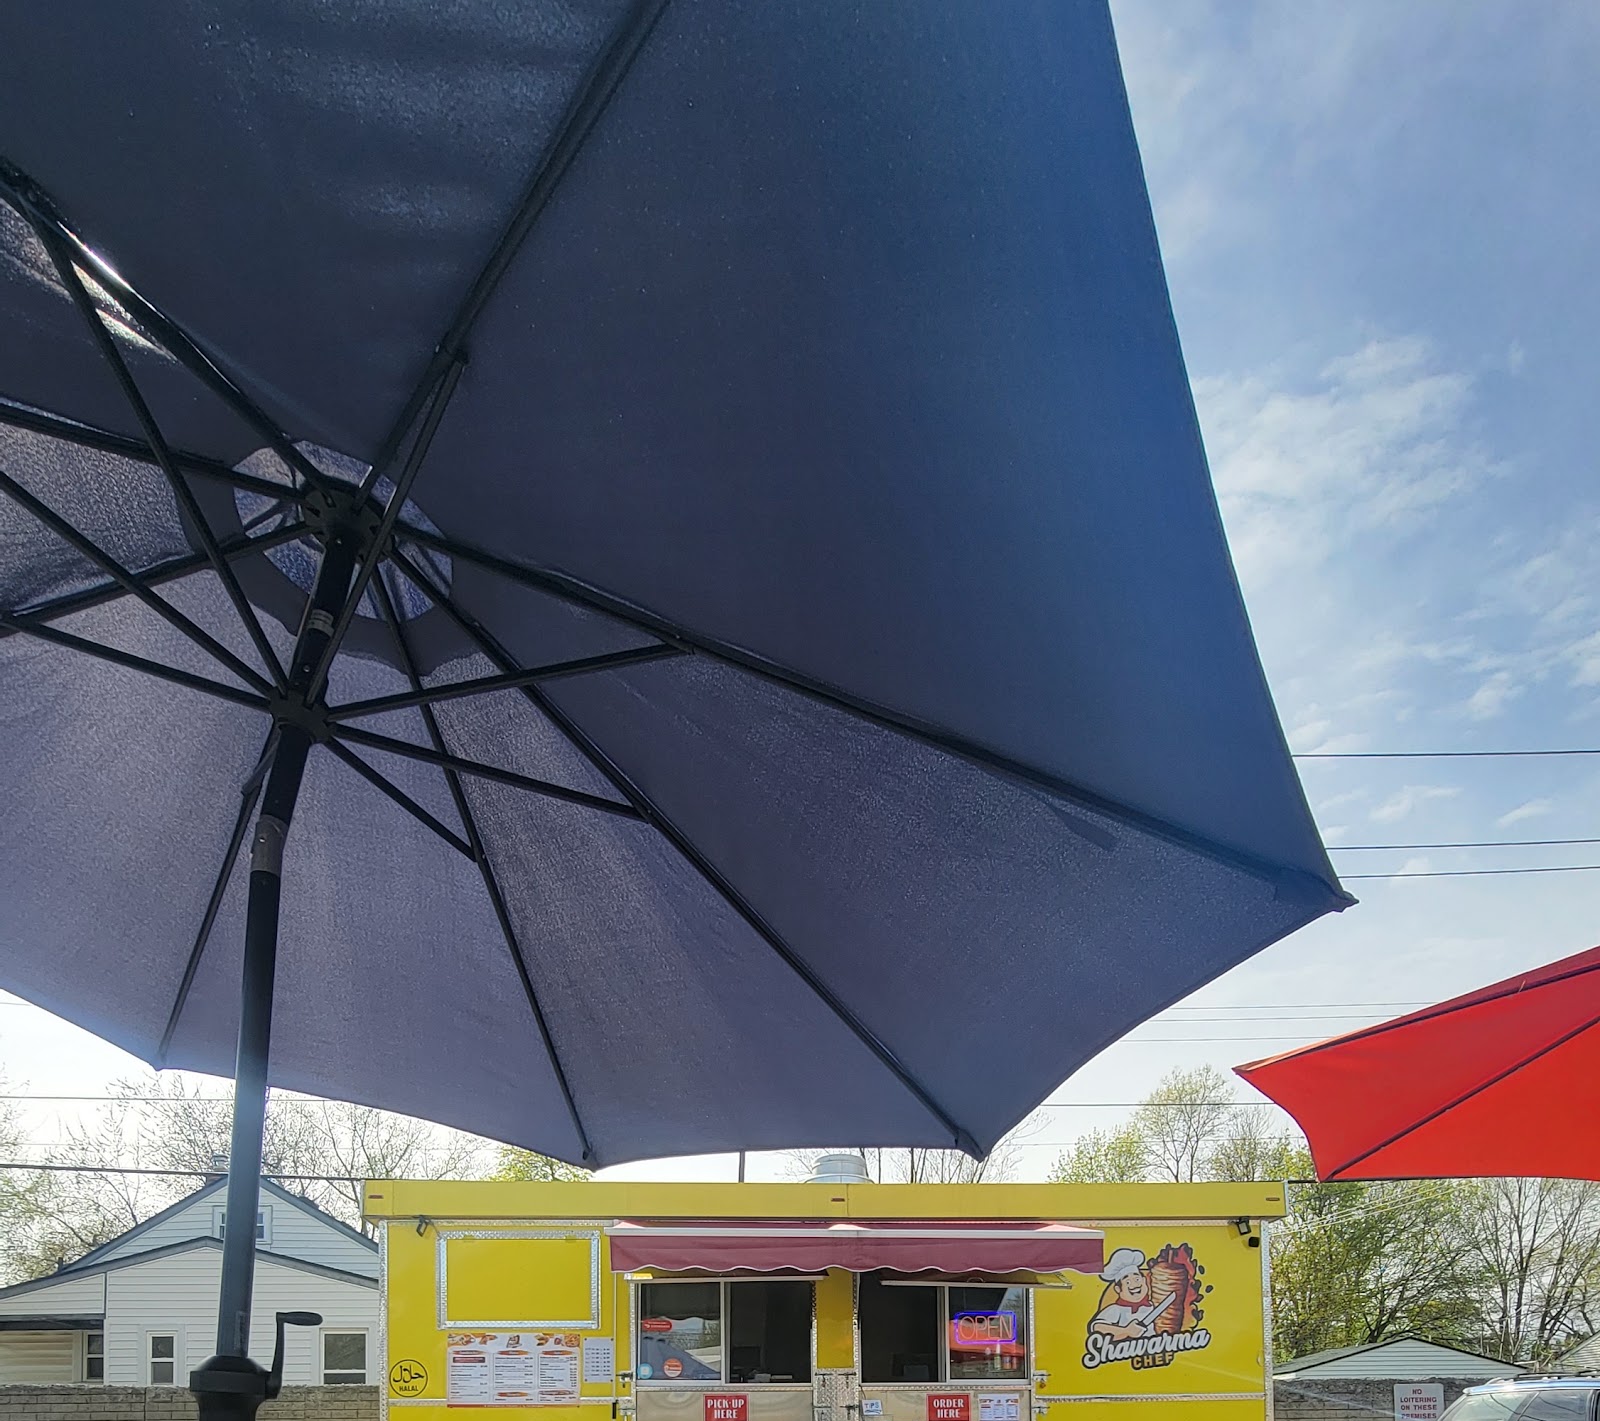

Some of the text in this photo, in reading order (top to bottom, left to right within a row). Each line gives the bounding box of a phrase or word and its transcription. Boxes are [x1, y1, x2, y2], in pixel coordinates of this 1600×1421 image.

[960, 1314, 1012, 1340] OPEN
[1083, 1329, 1210, 1368] Shawarma
[1132, 1352, 1174, 1369] CHEF
[393, 1364, 425, 1384] حلال
[933, 1398, 965, 1409] ORDER
[714, 1409, 738, 1419] HERE
[937, 1409, 961, 1419] HERE
